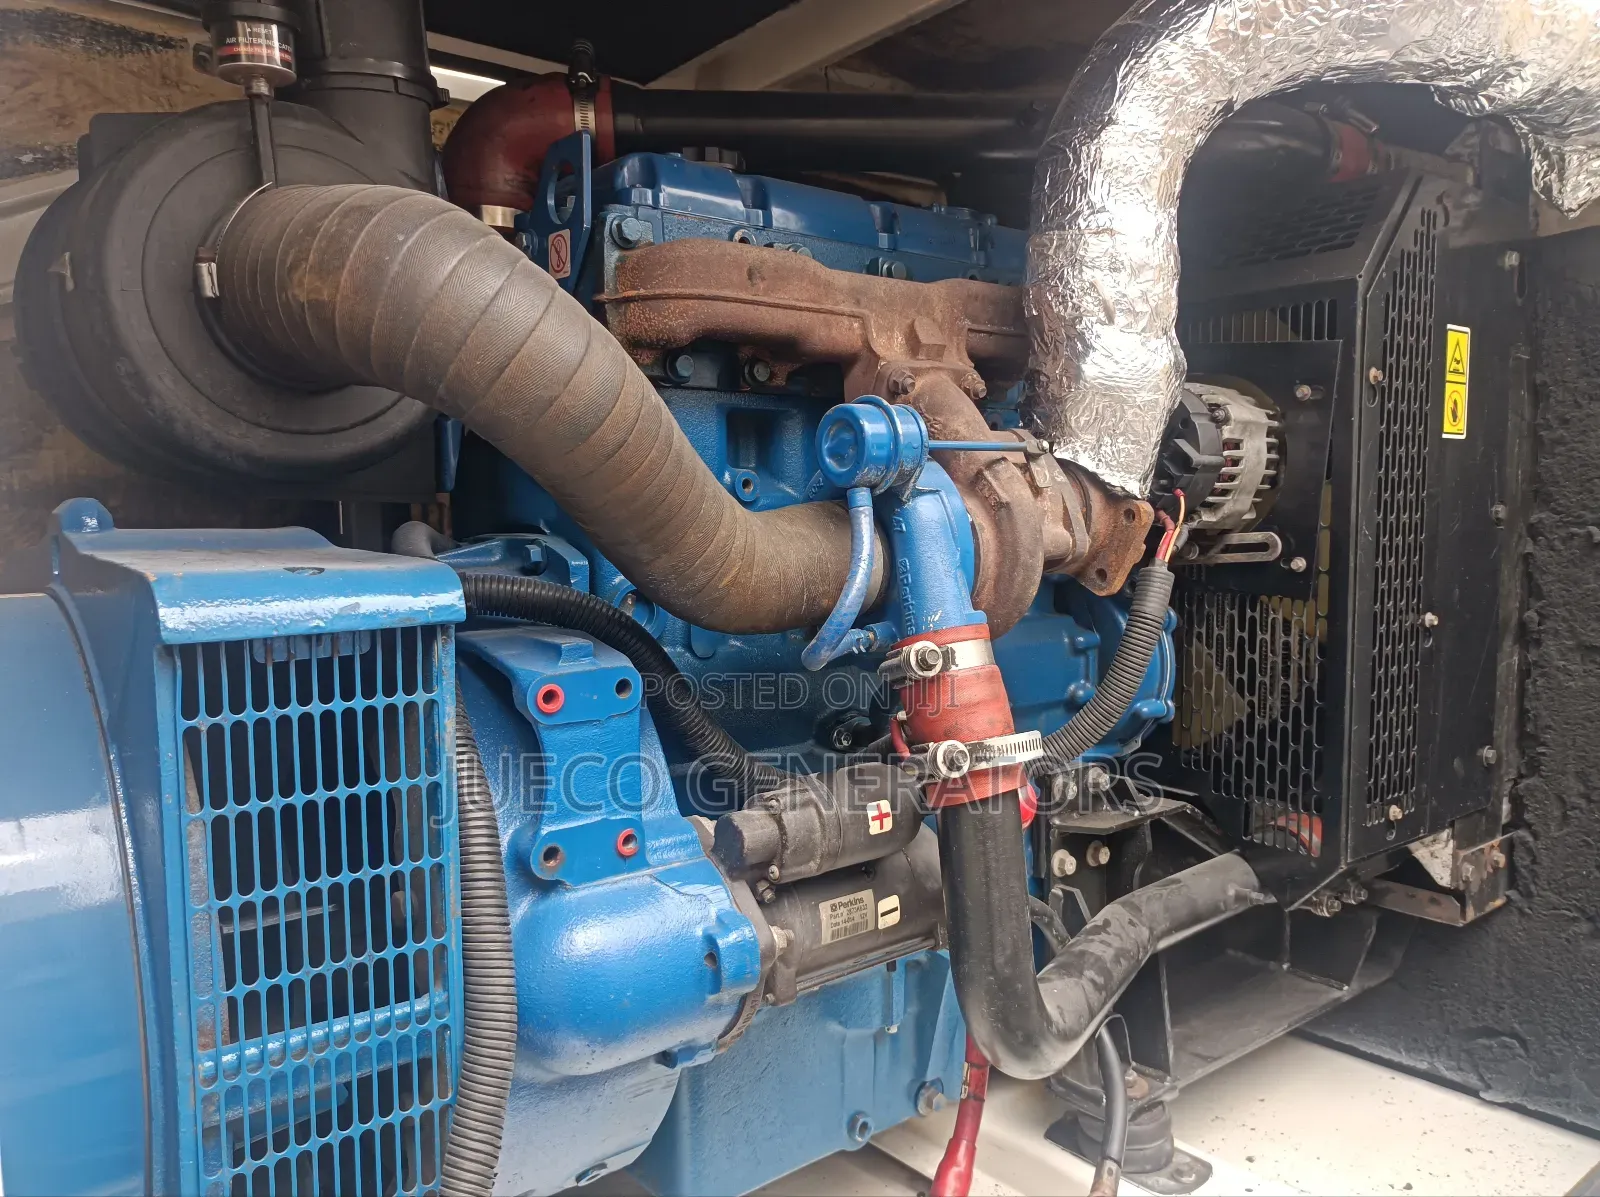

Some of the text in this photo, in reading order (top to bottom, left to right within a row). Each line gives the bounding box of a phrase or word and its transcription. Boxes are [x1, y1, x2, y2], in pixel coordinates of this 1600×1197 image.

[225, 36, 237, 45] AIR
[238, 36, 263, 45] FILTER
[899, 571, 917, 636] Perkins
[838, 897, 864, 910] Perkins
